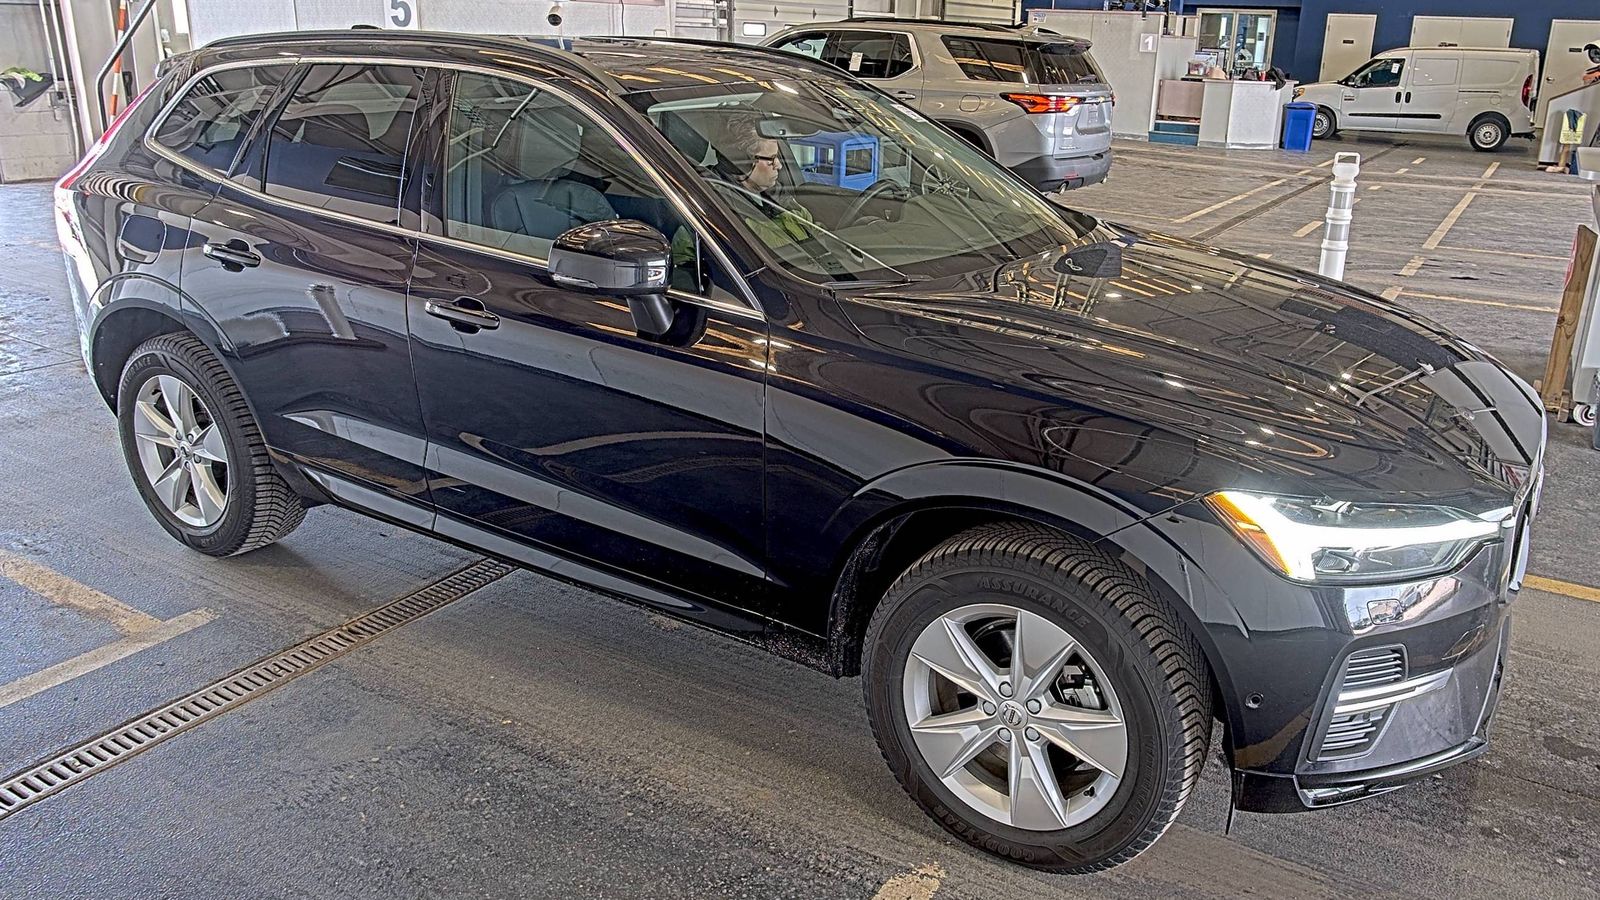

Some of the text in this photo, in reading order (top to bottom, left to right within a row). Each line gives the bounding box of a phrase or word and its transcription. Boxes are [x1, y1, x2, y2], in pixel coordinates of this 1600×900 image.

[391, 0, 411, 27] 5
[1144, 35, 1153, 51] 1
[979, 576, 1090, 628] ASSURANCE
